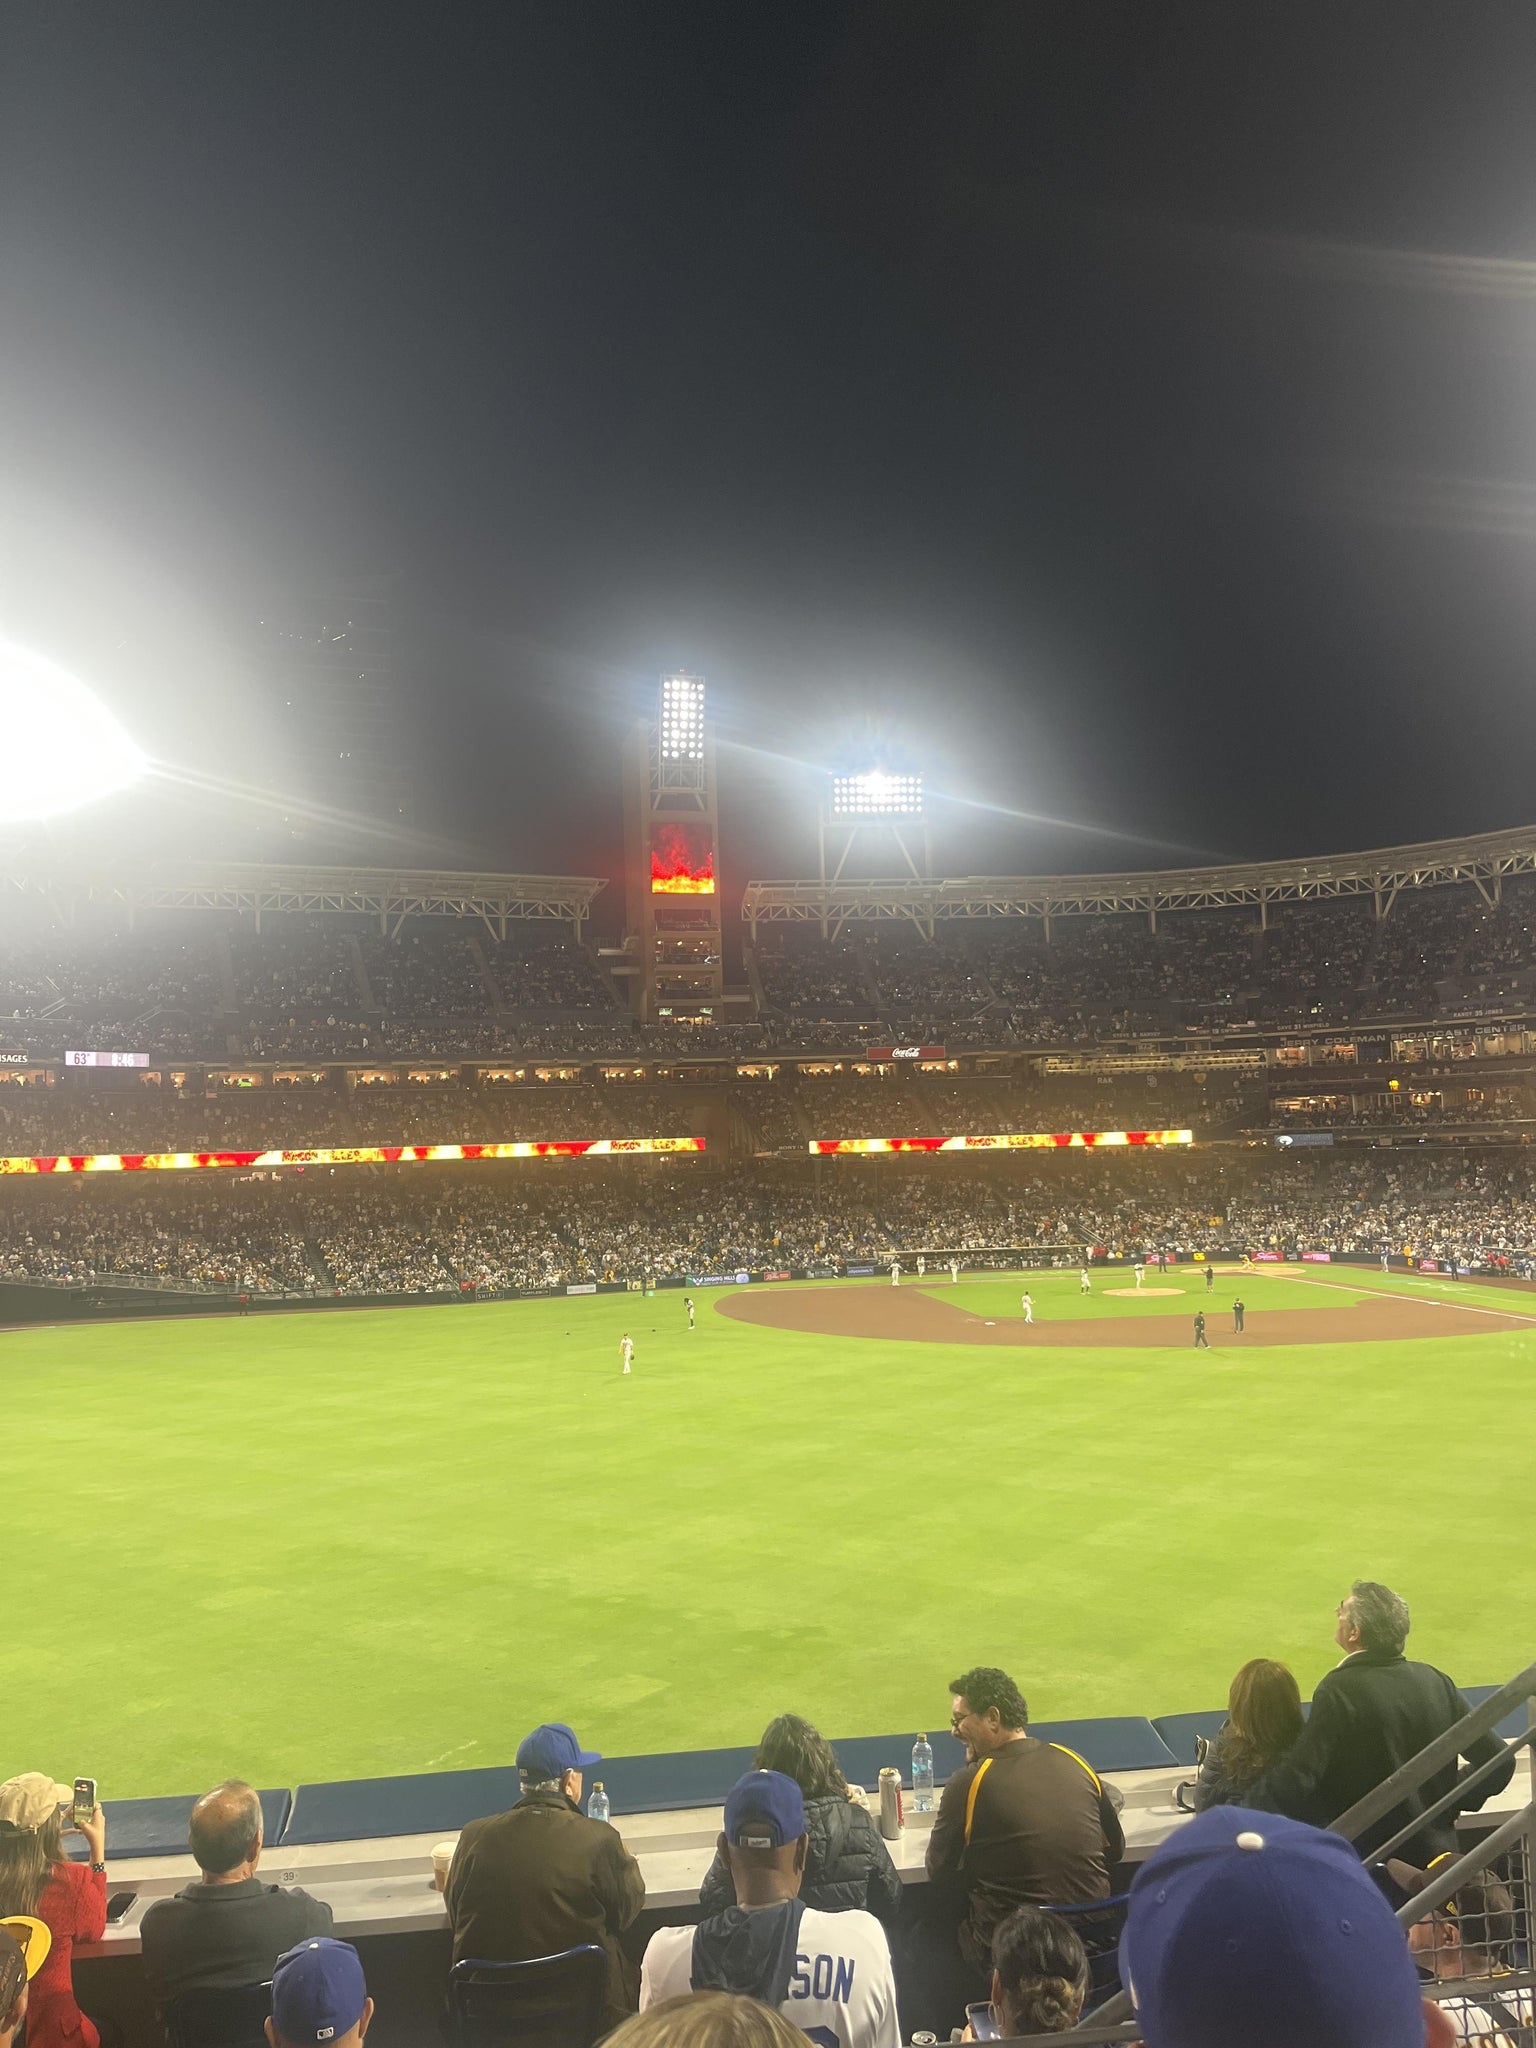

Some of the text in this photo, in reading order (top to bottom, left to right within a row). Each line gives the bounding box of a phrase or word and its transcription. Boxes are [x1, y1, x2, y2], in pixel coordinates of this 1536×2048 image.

[1280, 1024, 1526, 1047] JERRY COLEMAN BROADCAST CENTER
[0, 1054, 28, 1063] SAGES
[283, 1872, 295, 1881] 39
[790, 1953, 855, 2004] SON
